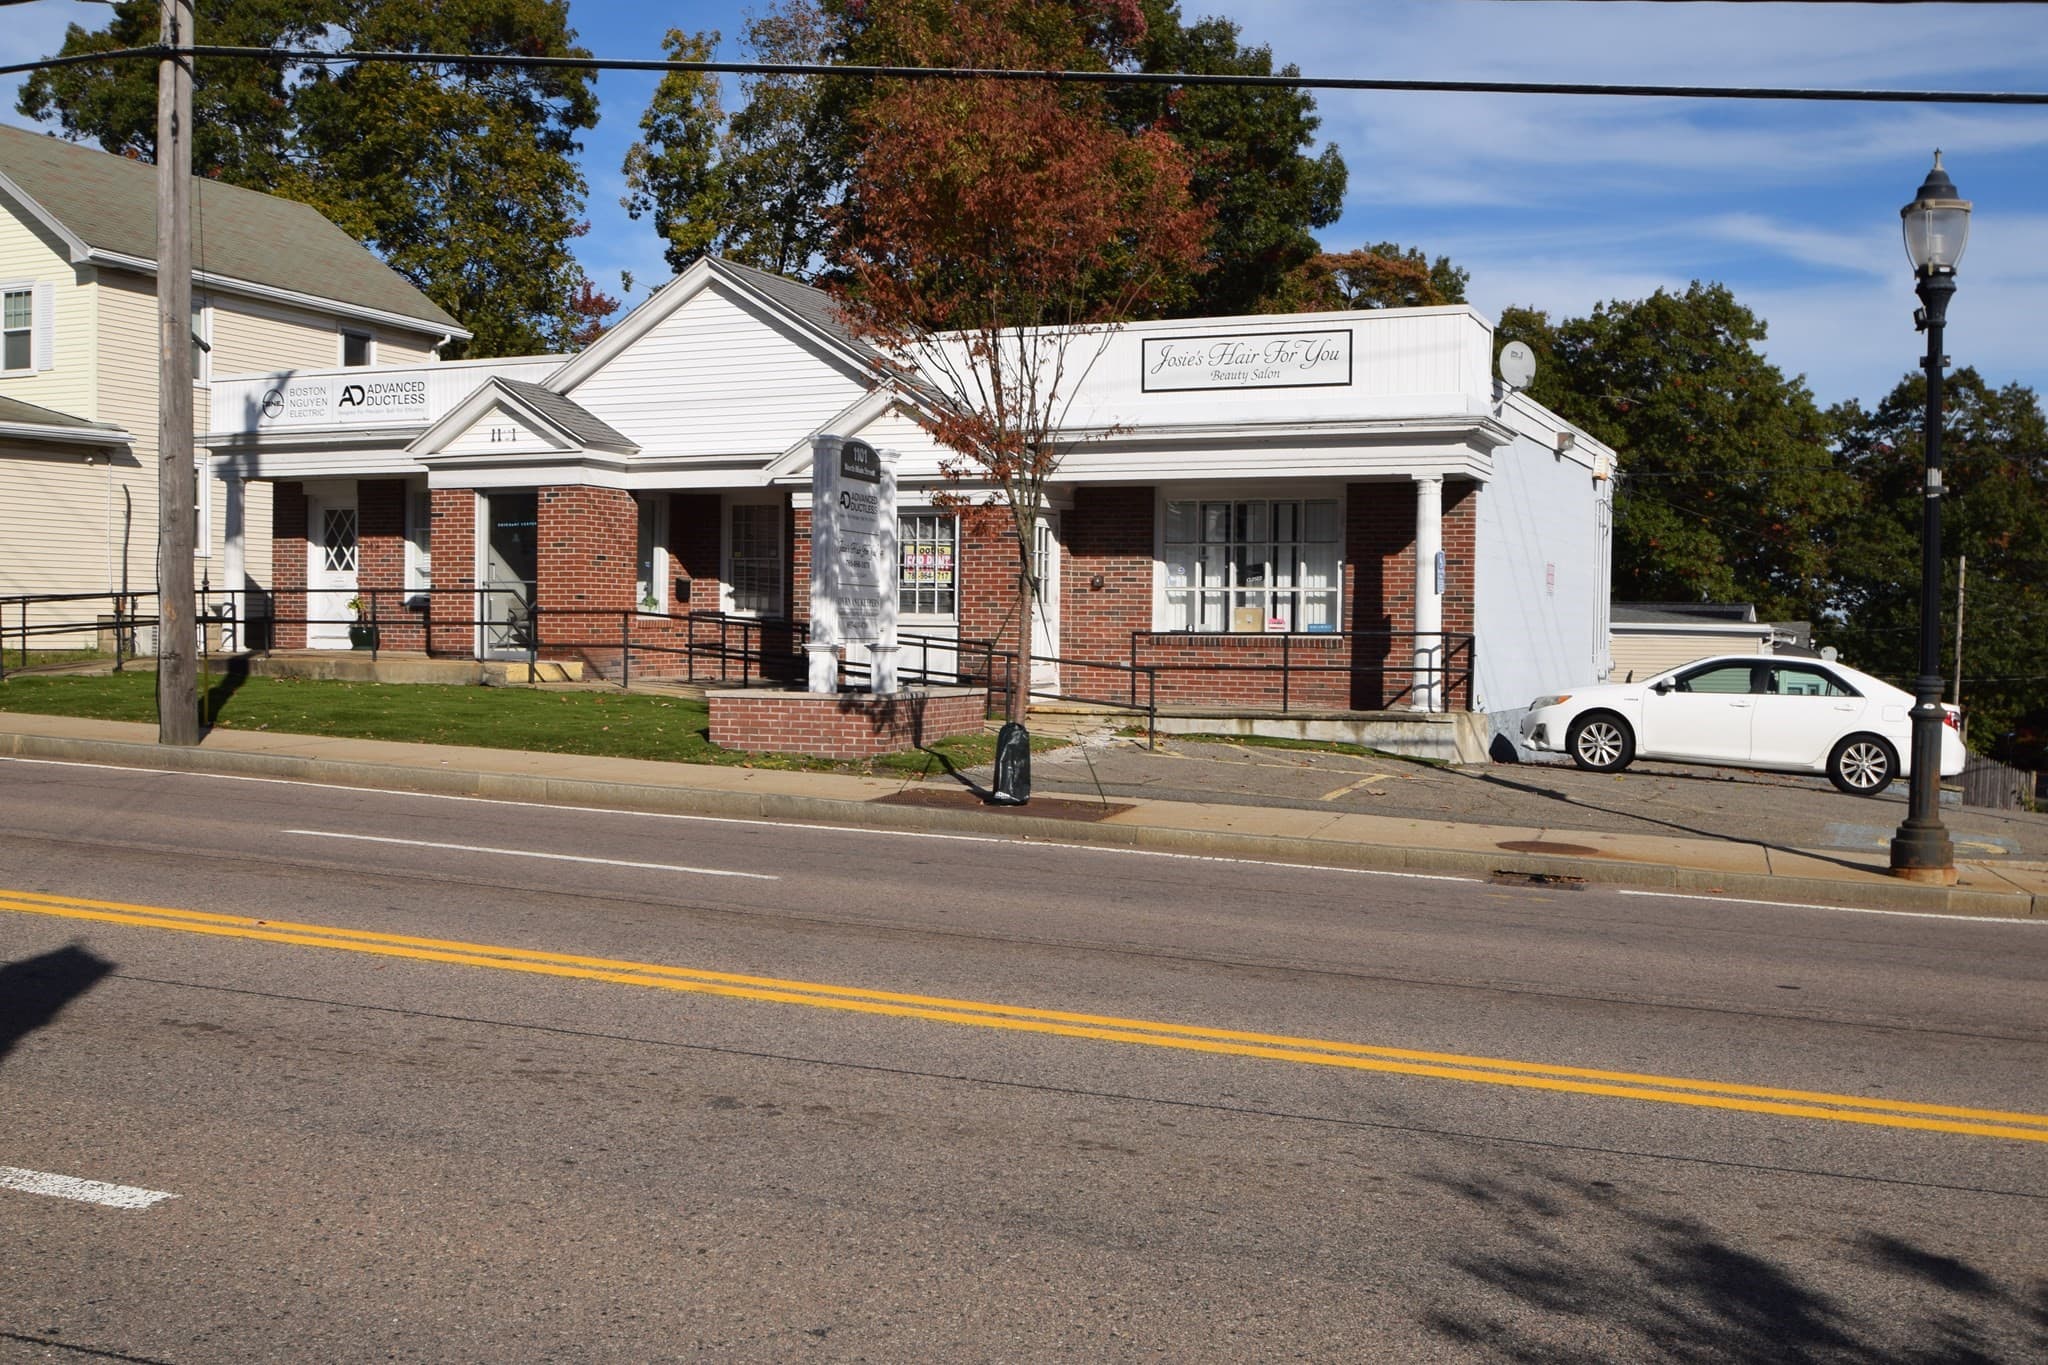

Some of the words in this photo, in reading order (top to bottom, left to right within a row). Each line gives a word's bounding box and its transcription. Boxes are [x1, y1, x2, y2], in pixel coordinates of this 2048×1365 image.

[1150, 344, 1203, 375] Josie's
[1208, 342, 1260, 367] Hair
[1264, 340, 1298, 364] For
[1294, 338, 1340, 370] You
[1210, 369, 1249, 384] Beauty
[1250, 367, 1280, 381] Salon
[289, 386, 327, 397] BOSTON
[367, 381, 425, 394] ADVANCED
[289, 397, 328, 408] NGUYEN
[338, 385, 365, 407] AD
[366, 393, 425, 406] DUCTLESS
[289, 408, 325, 418] ELECTRIC
[851, 492, 878, 505] ADVANCED
[850, 502, 878, 515] DUCTLESS
